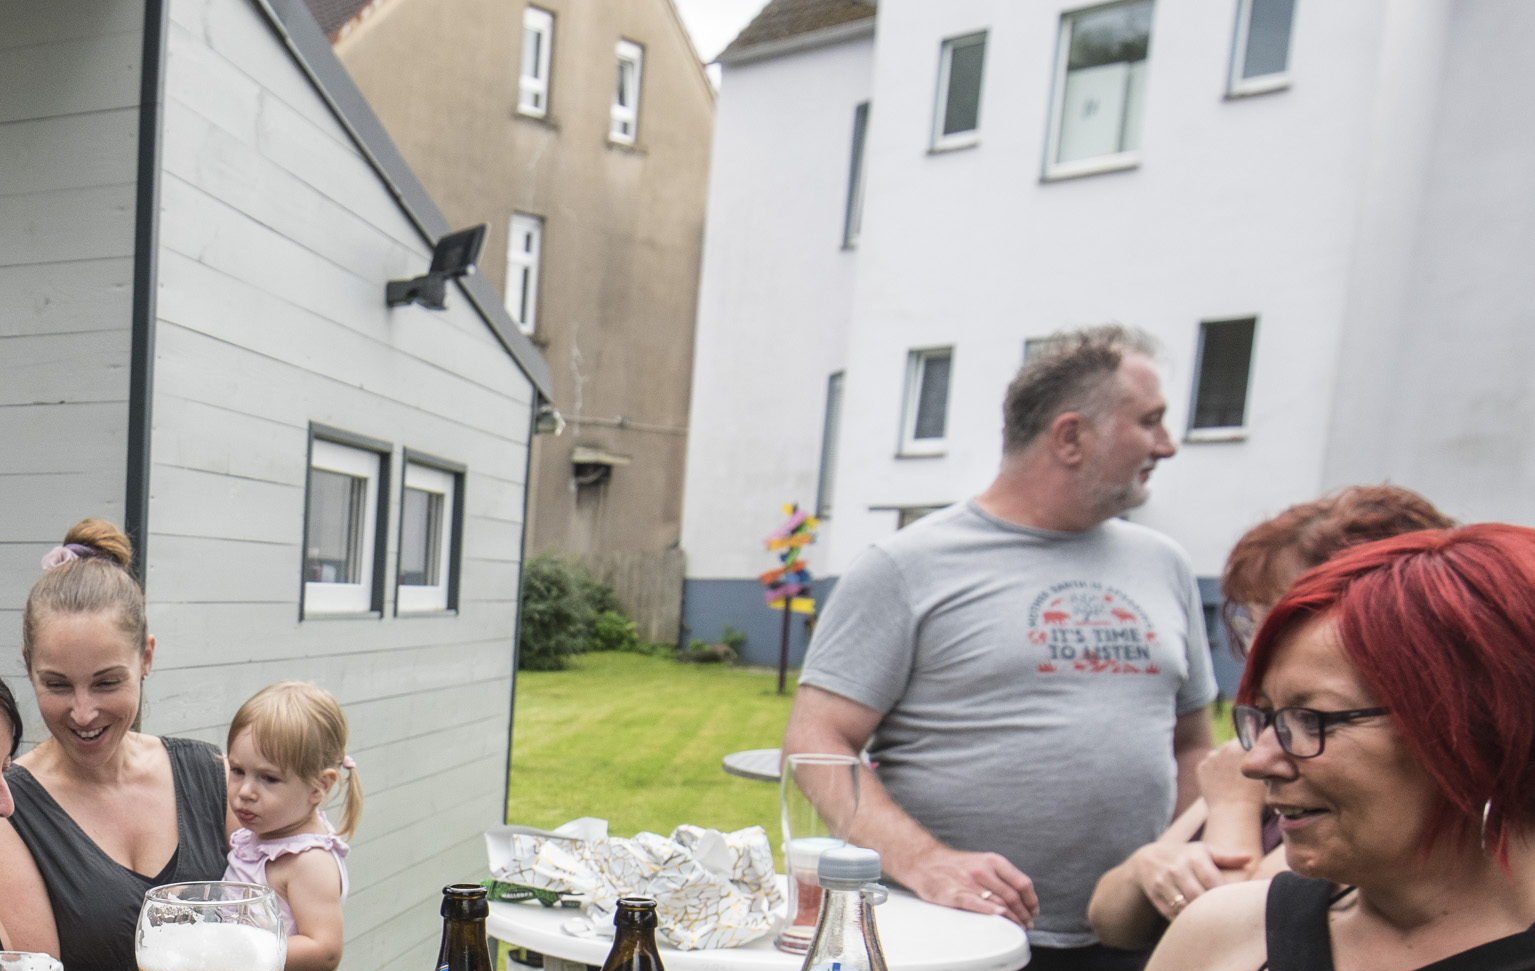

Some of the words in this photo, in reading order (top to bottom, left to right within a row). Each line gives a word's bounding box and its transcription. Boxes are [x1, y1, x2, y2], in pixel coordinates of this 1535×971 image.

[1051, 628, 1085, 643] IT'S
[1092, 628, 1141, 643] TIME
[1048, 645, 1076, 661] TO
[1084, 645, 1151, 660] LISTEN
